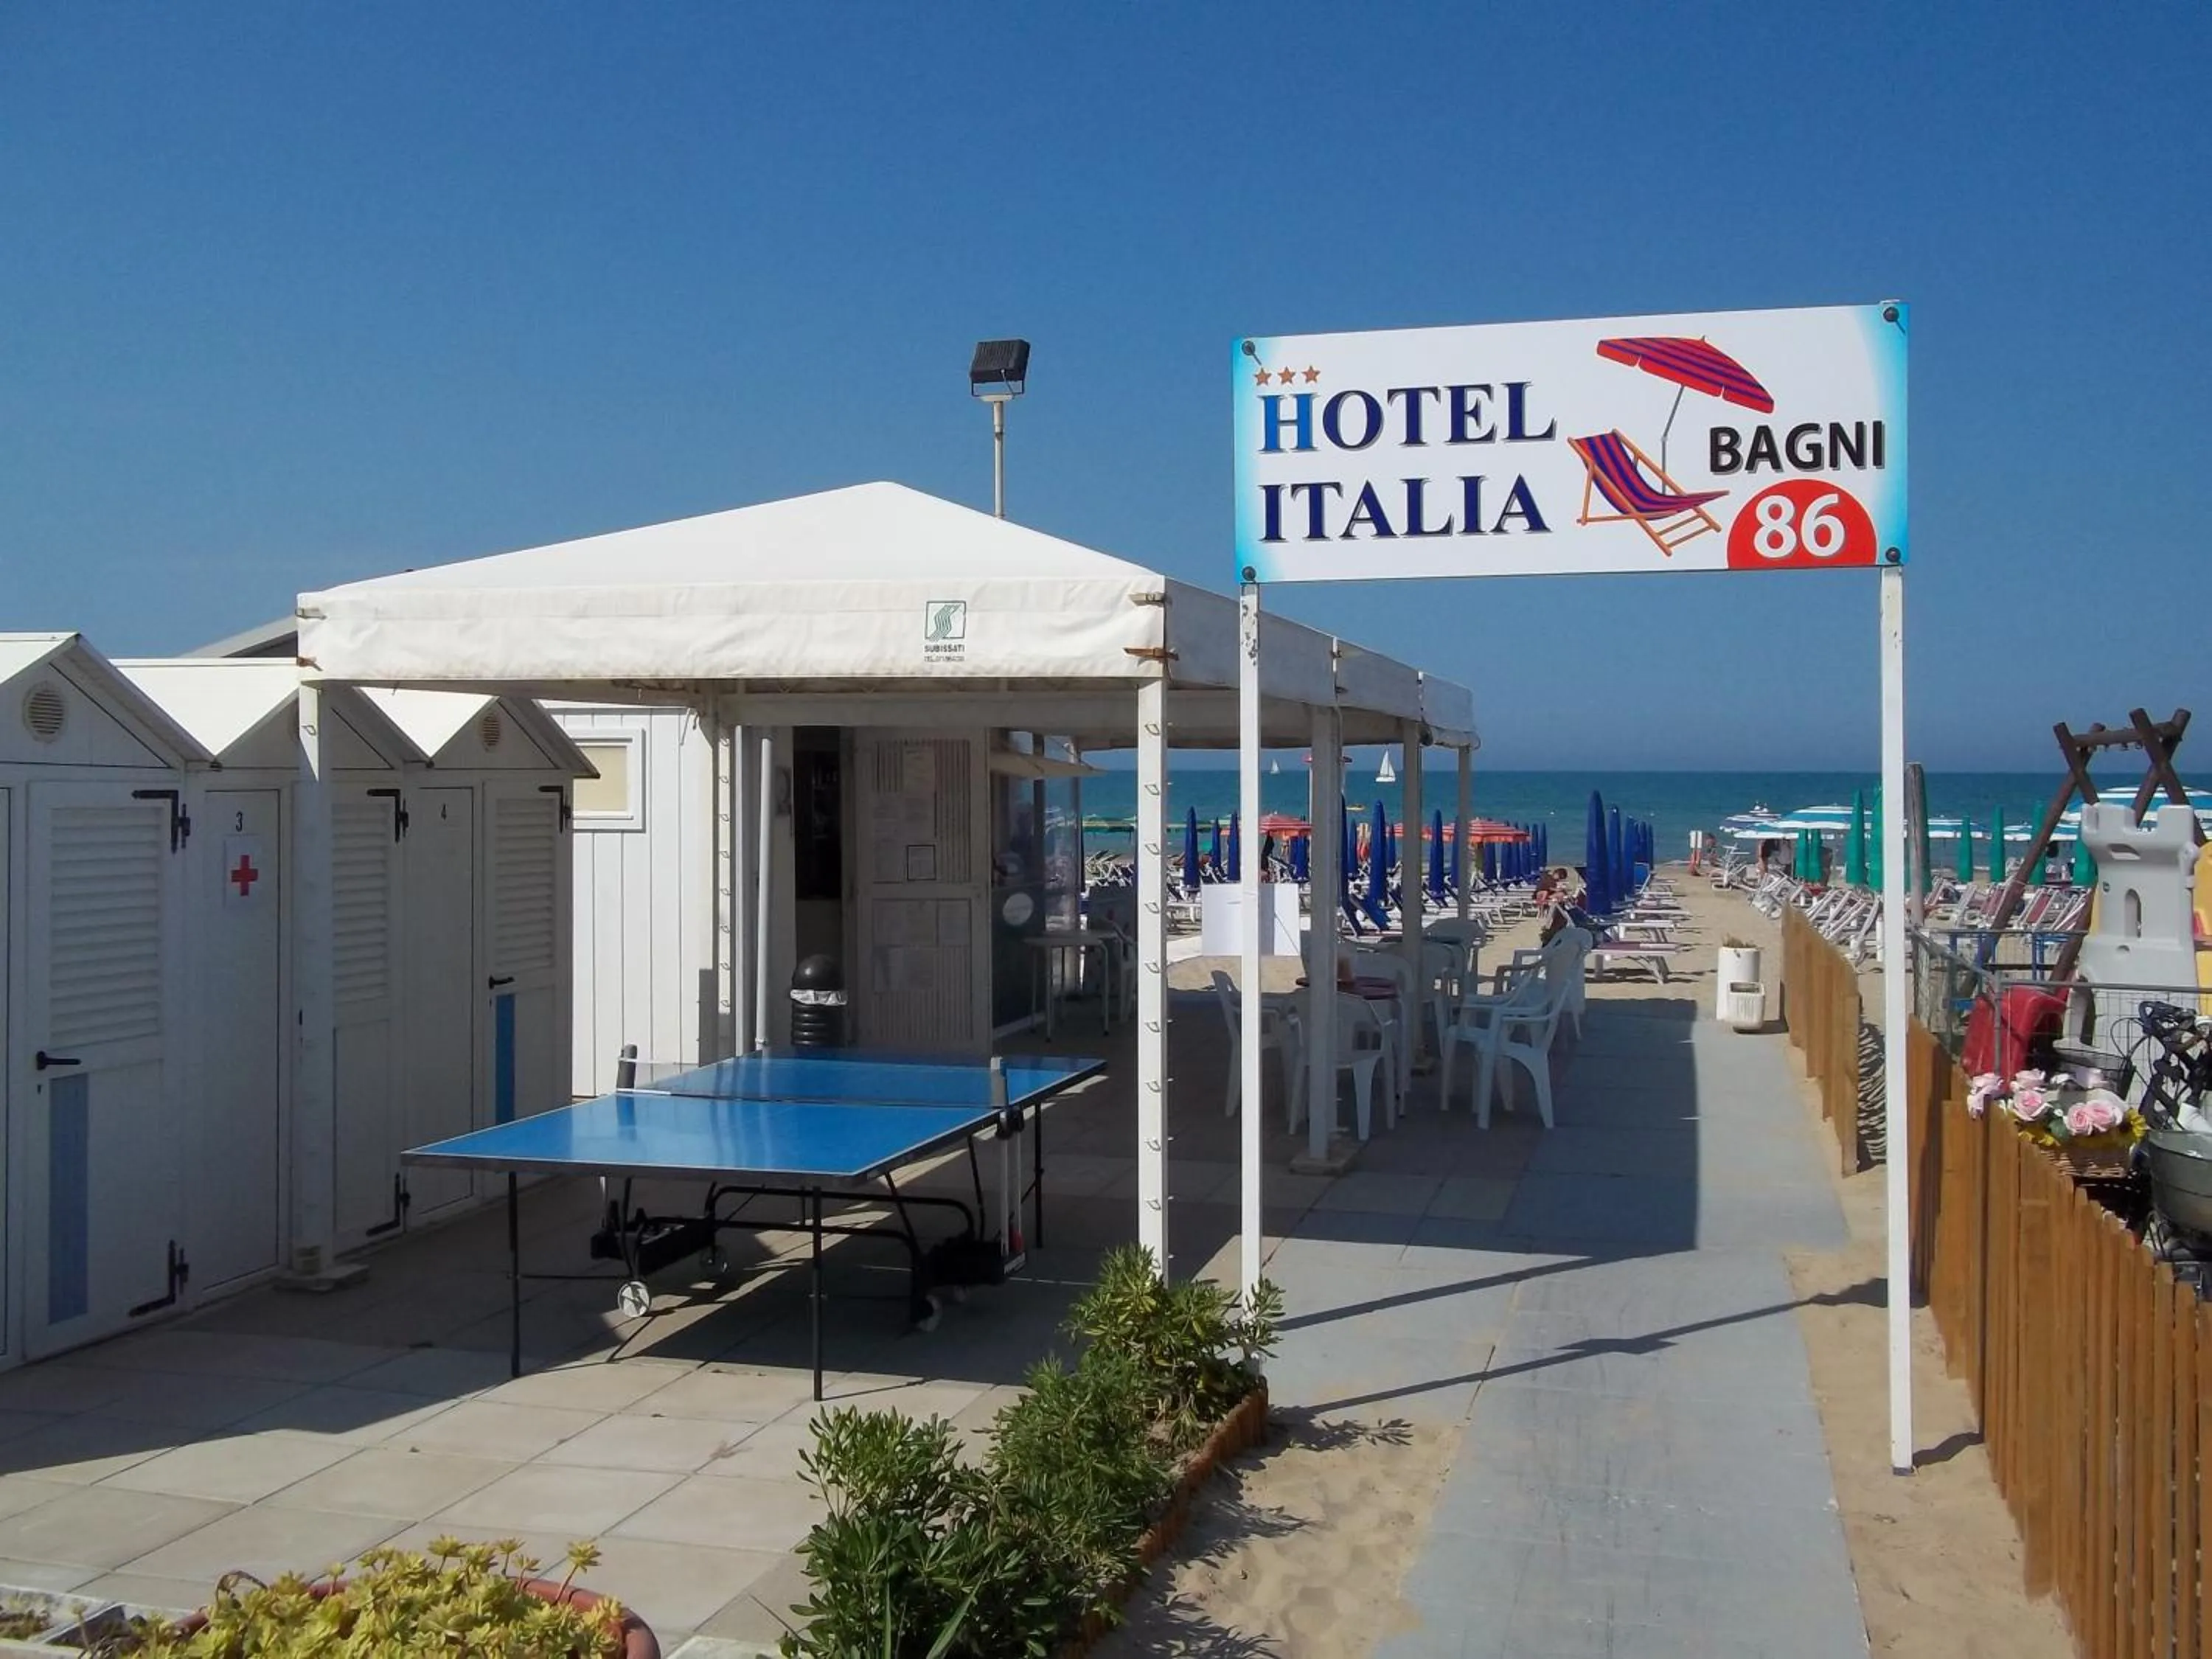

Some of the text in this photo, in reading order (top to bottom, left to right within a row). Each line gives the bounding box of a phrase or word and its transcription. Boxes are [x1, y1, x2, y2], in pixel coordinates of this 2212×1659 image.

[1258, 381, 1557, 454] HOTEL
[1710, 420, 1885, 474] BAGNI
[1258, 473, 1553, 543] ITALIA
[1753, 493, 1845, 559] 86
[235, 810, 243, 832] 3
[440, 803, 447, 820] 4
